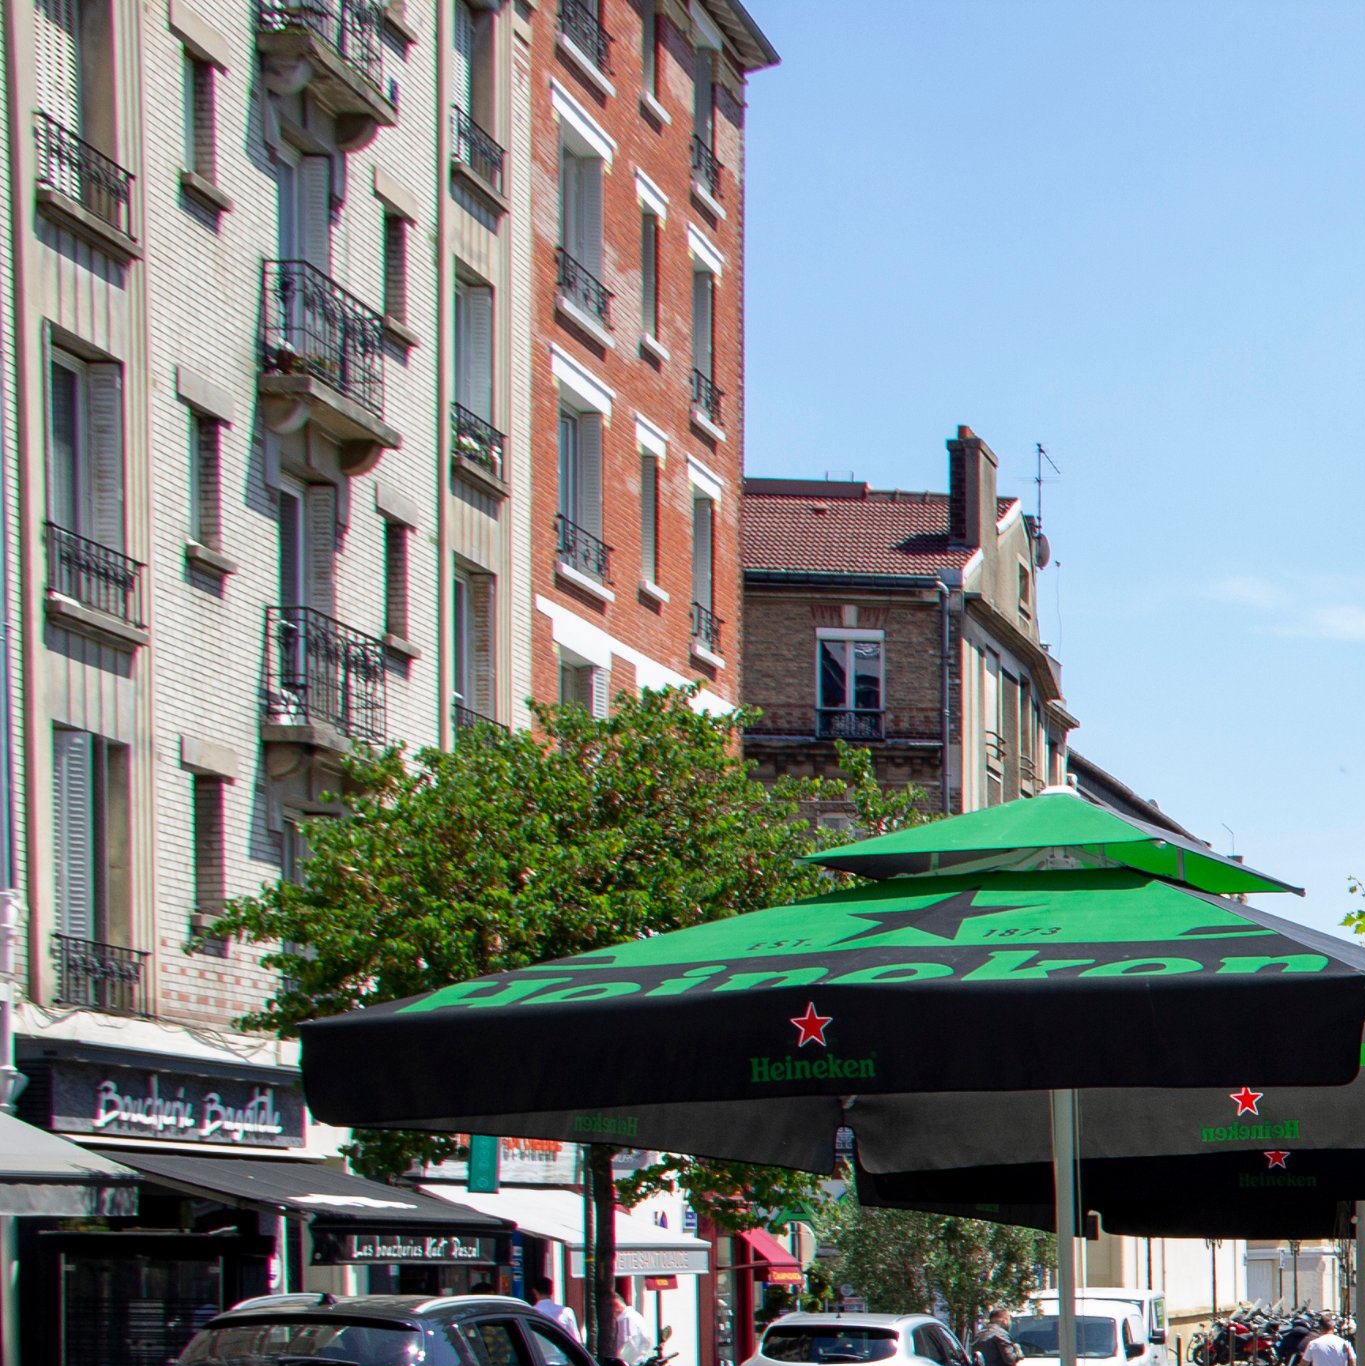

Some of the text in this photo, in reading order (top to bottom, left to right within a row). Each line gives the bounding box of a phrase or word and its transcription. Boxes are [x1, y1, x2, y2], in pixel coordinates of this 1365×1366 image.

[746, 938, 813, 951] EST.
[982, 925, 1062, 938] 1873
[398, 949, 1329, 1014] Heineken
[749, 1054, 876, 1083] Heineken
[92, 1073, 284, 1141] Boucherie Bagatelle
[1238, 1173, 1318, 1188] Heineken
[352, 1234, 374, 1259] Les
[374, 1234, 423, 1260] boucheries
[449, 1235, 480, 1260] Pascal
